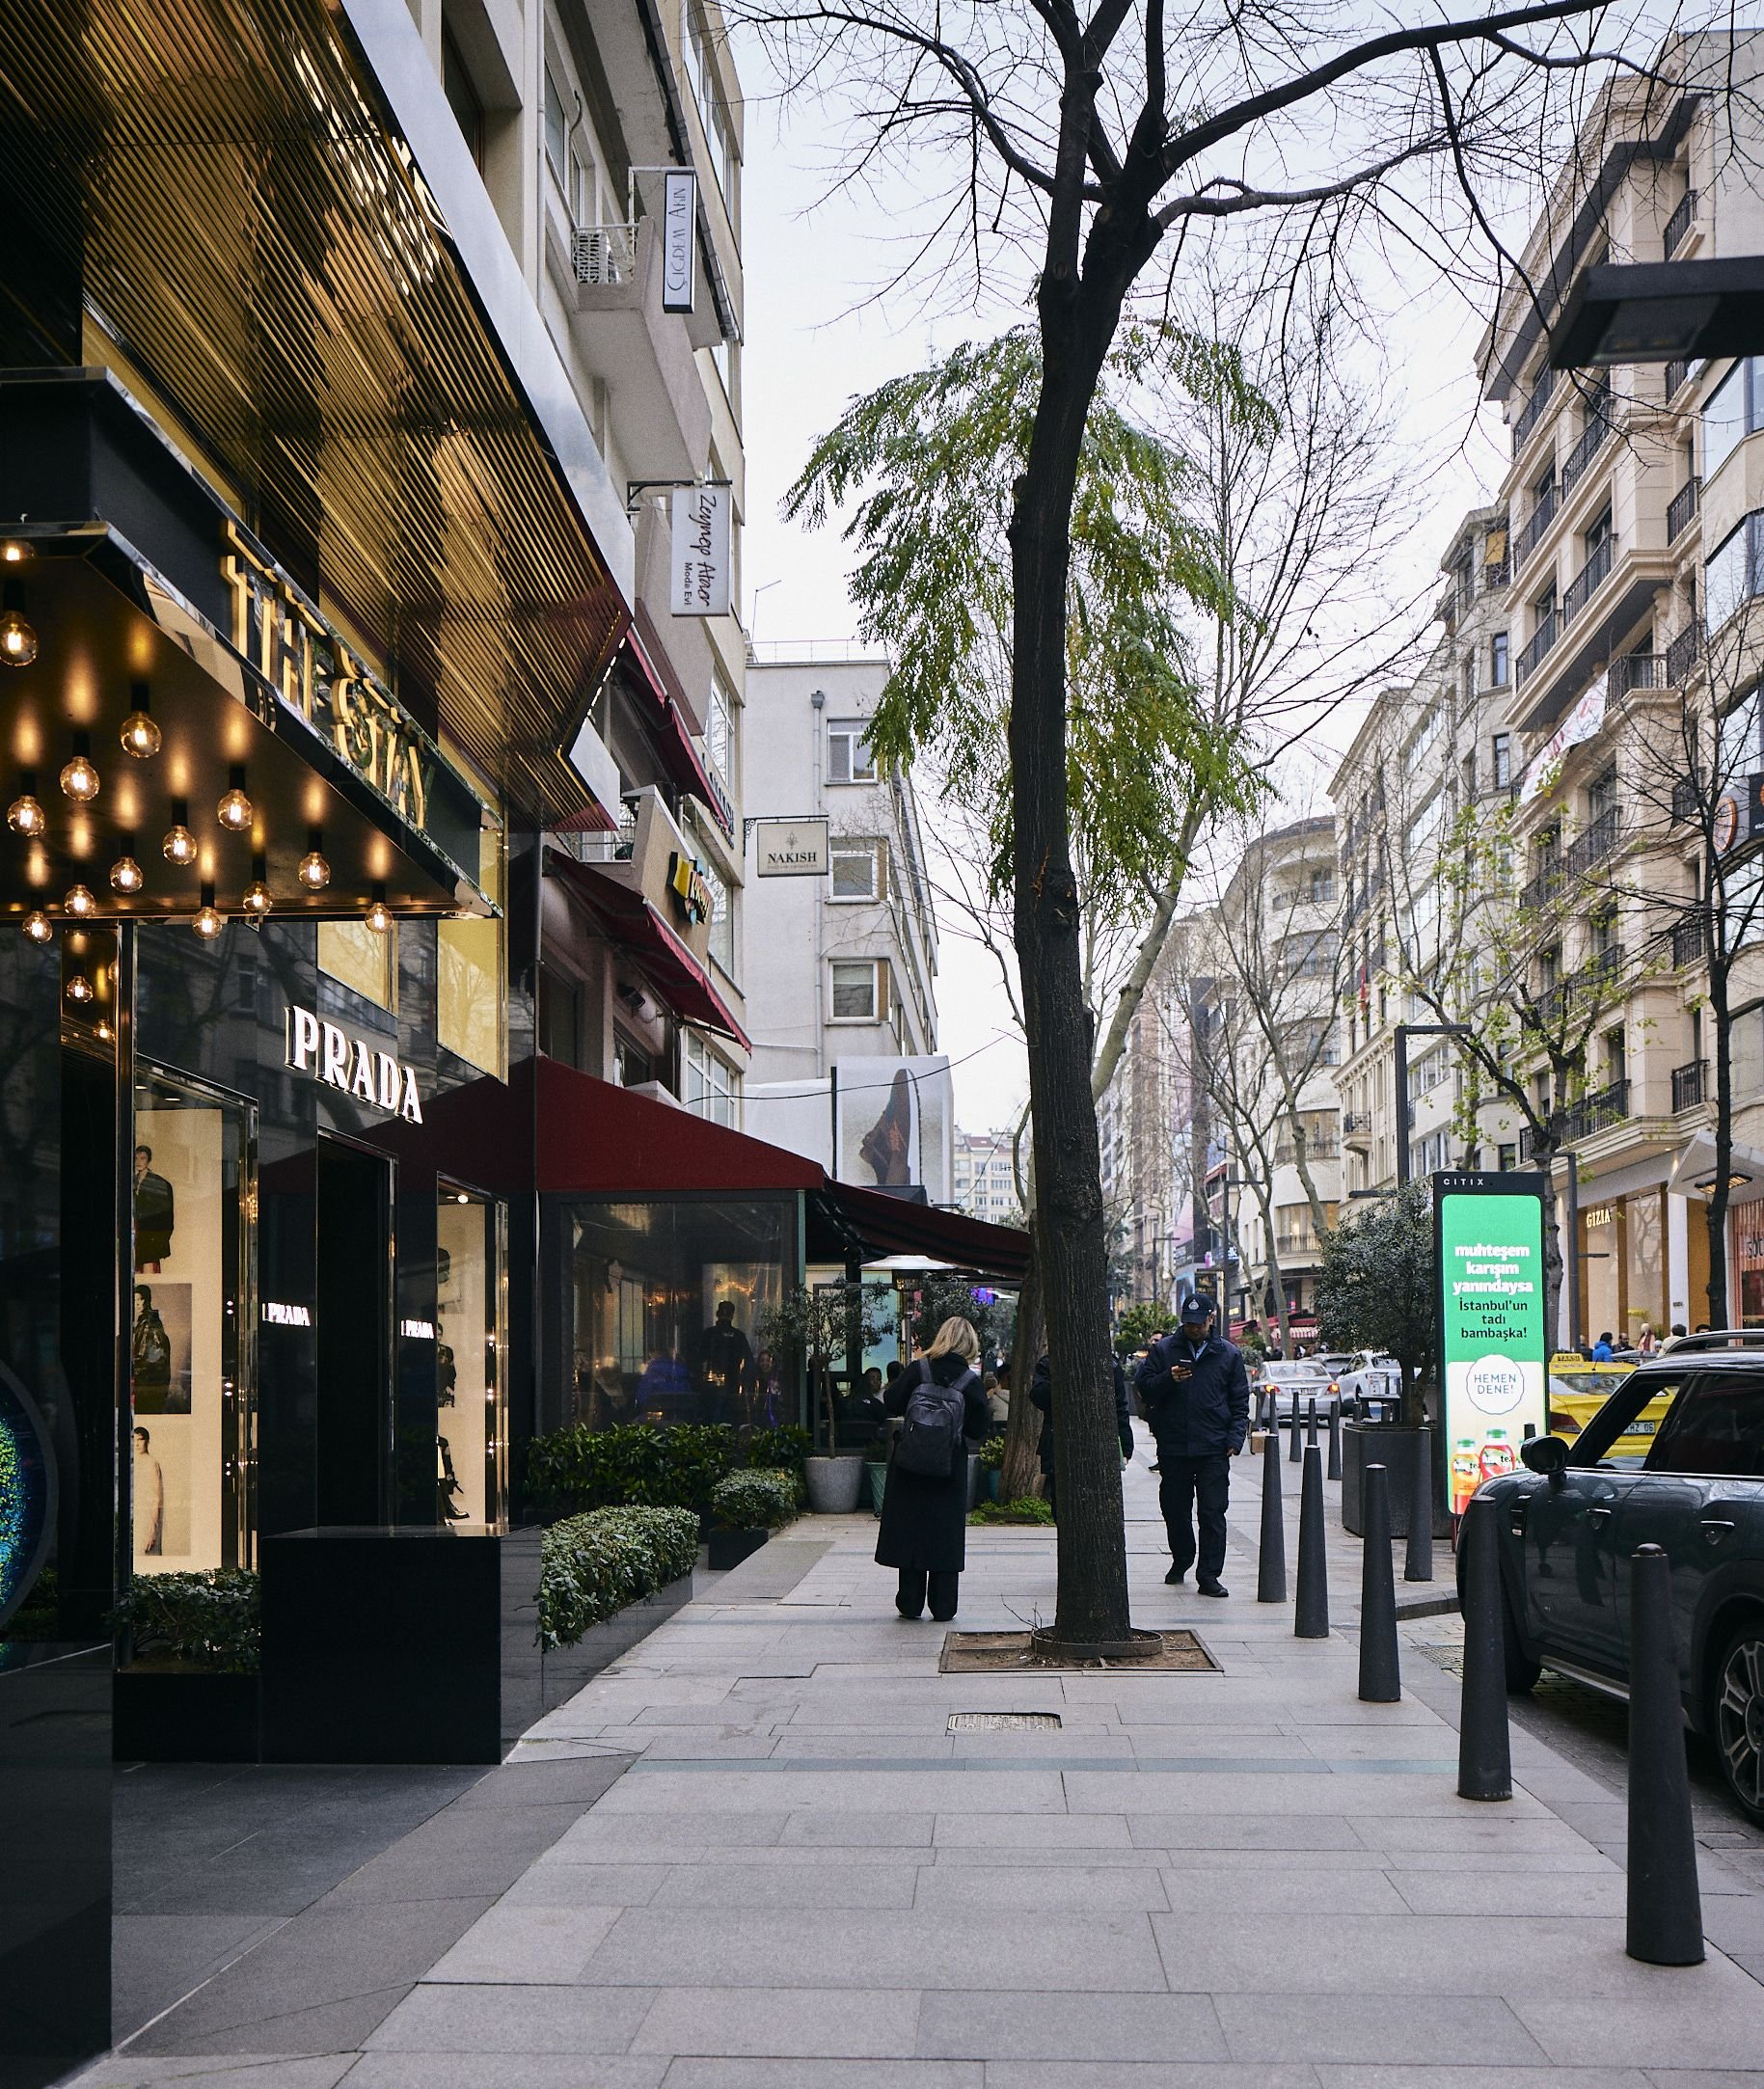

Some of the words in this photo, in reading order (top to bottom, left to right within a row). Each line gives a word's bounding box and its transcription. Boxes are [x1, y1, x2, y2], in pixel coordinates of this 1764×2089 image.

[689, 494, 718, 556] Zeynep
[684, 562, 692, 587] Moda
[767, 852, 818, 864] NAKISH
[285, 1005, 423, 1125] PRADA
[1443, 1178, 1484, 1186] CITIX
[1586, 1208, 1612, 1229] GIZIA
[1454, 1243, 1531, 1262] muhteşem
[1466, 1262, 1520, 1279] karışım
[1452, 1278, 1533, 1295] yanındaysa
[1459, 1297, 1528, 1312] İstanbul'un
[265, 1302, 311, 1327] PRADA
[1481, 1314, 1506, 1325] tadı
[403, 1319, 435, 1340] PRADA
[1461, 1327, 1528, 1342] bambaşka!
[1474, 1373, 1516, 1383] HEMEN
[1478, 1384, 1514, 1395] DENE!
